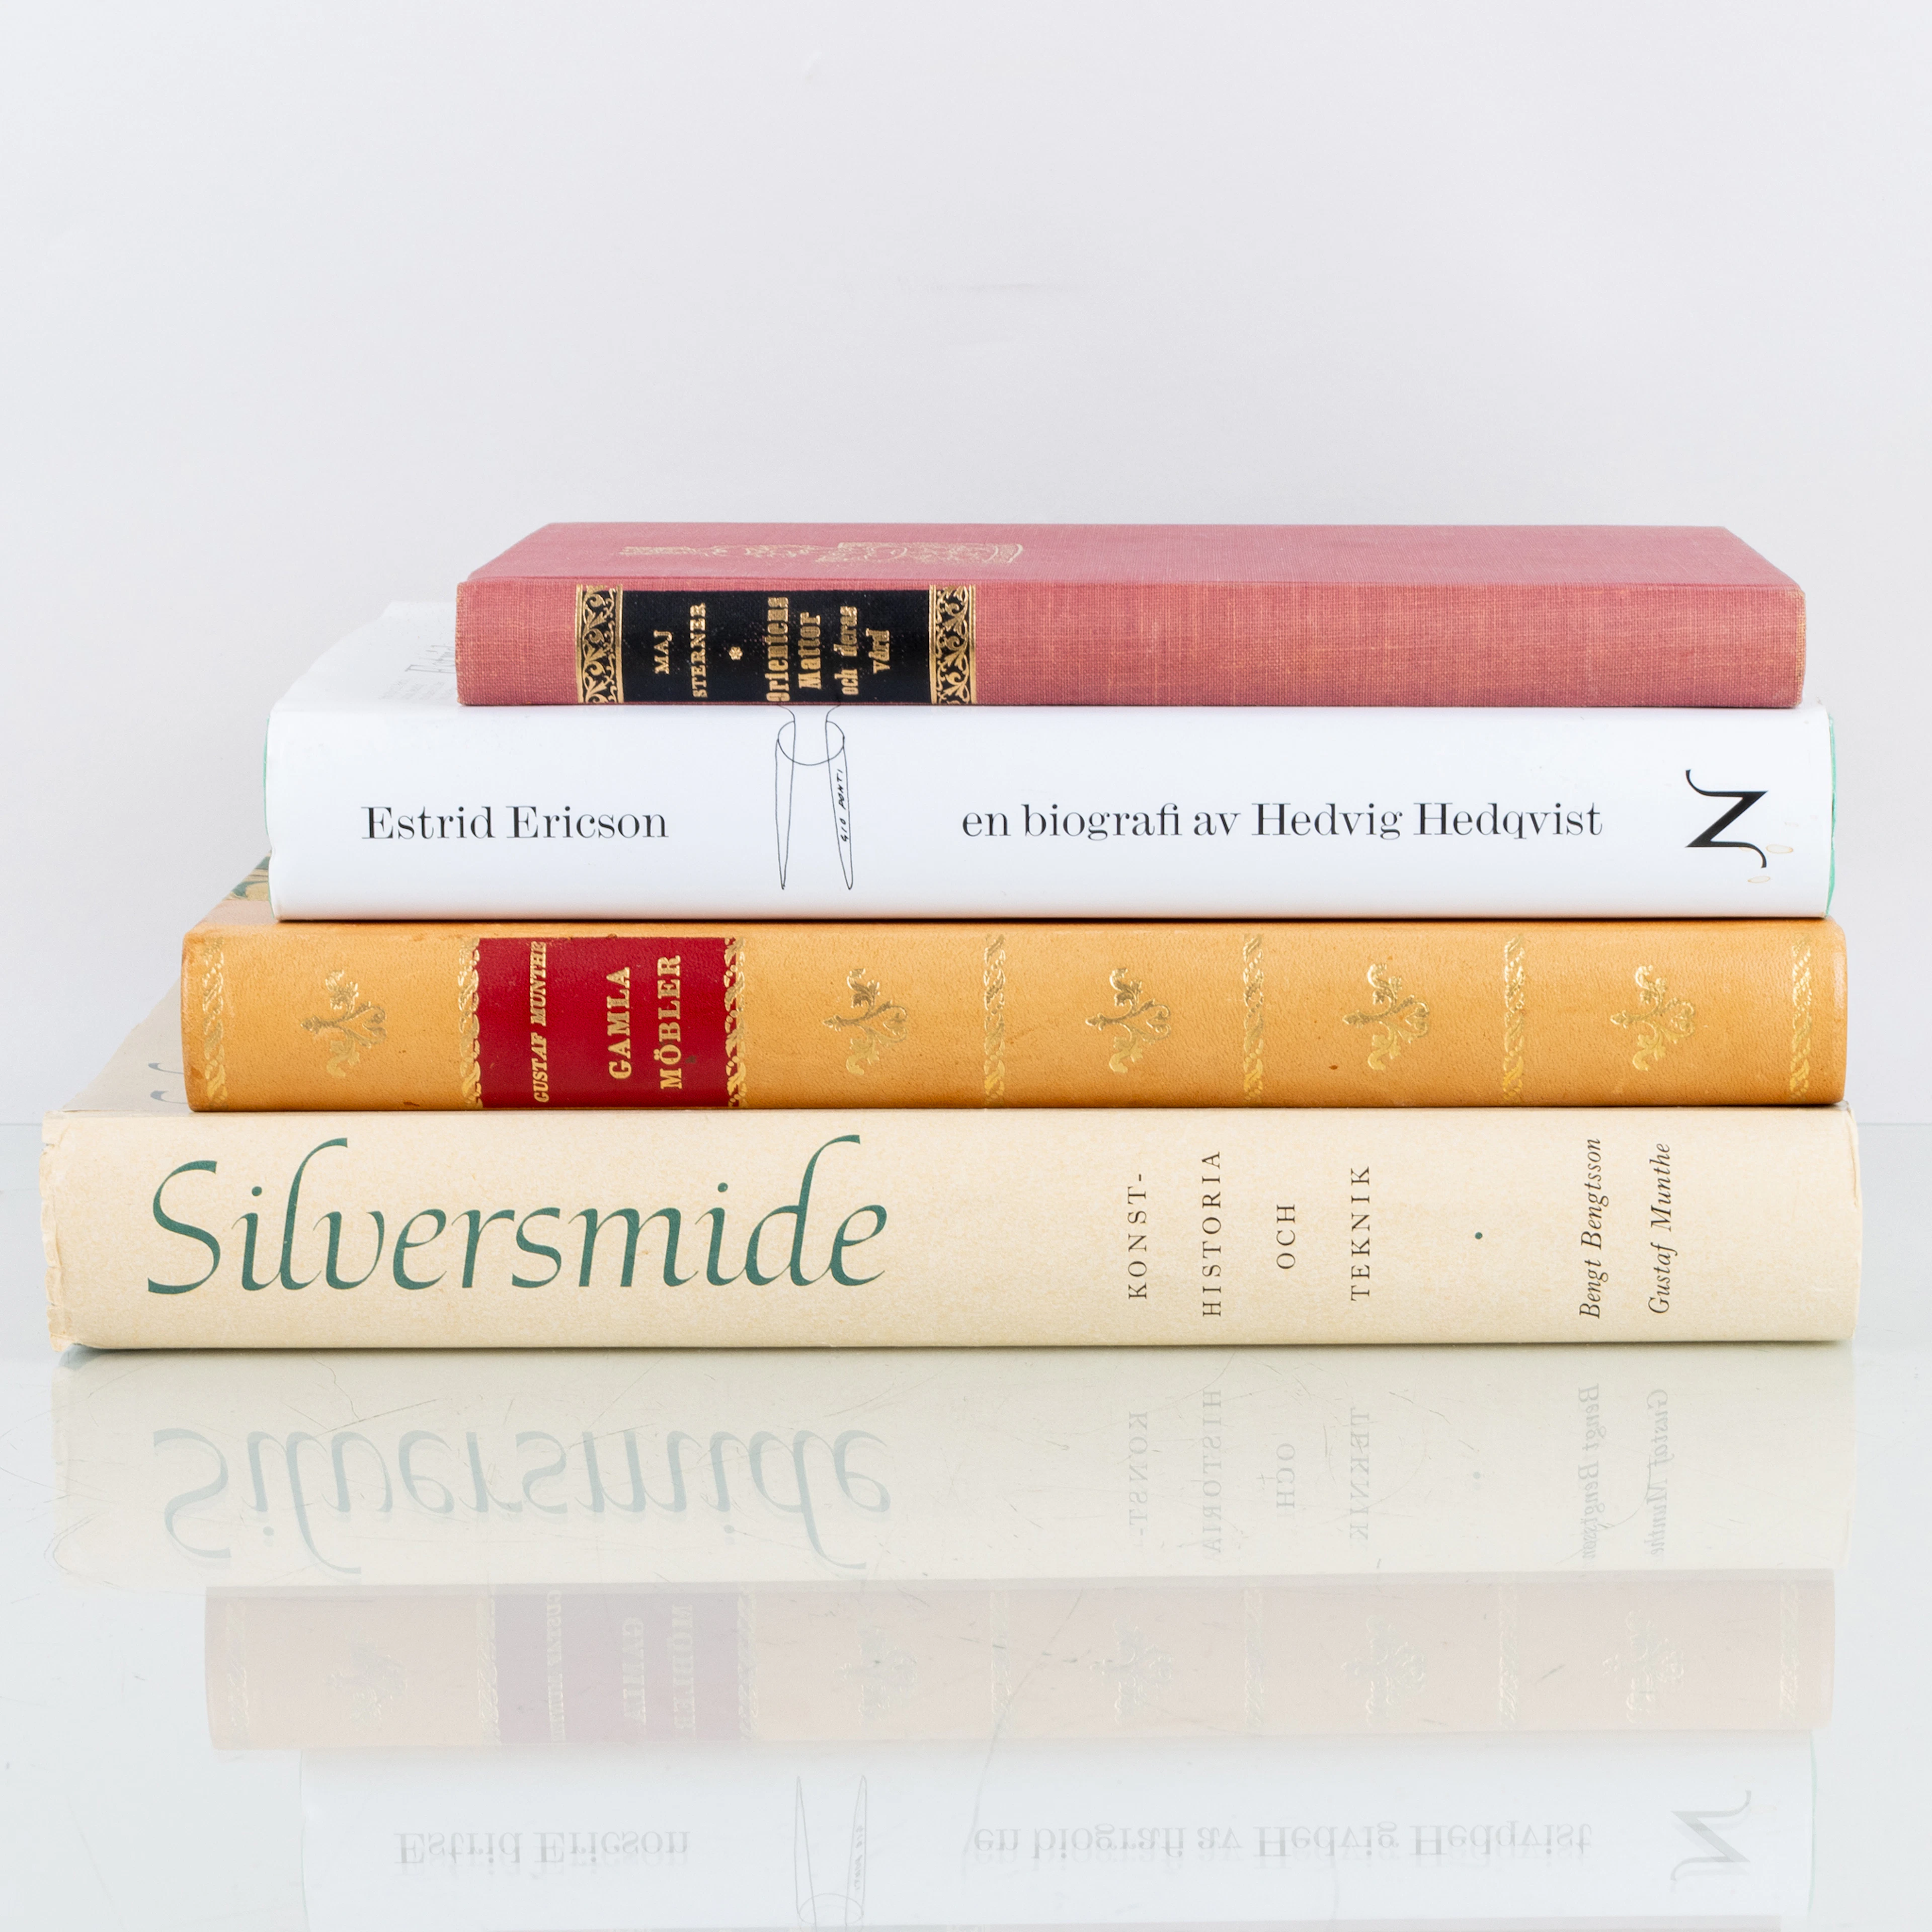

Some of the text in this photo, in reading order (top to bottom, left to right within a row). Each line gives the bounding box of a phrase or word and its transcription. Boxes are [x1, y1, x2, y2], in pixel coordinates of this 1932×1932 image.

[653, 630, 673, 675] MAJ
[689, 603, 707, 698] STERNER
[764, 596, 790, 702] Orientens
[797, 611, 822, 689] Mattor
[833, 606, 859, 695] och deras
[362, 806, 669, 839] Estrid Ericson
[836, 768, 849, 842] GIO PONTI
[962, 801, 1603, 841] en biografi av Hedvig Hedqvist
[529, 941, 550, 1103] GUSTAF MUNTHE
[606, 966, 632, 1080] GAMLA
[653, 954, 683, 1090] MÖBLER
[147, 1134, 888, 1295] Silversmide
[1127, 1172, 1148, 1300] KONST-
[1201, 1151, 1222, 1317] HISTORIA
[1275, 1203, 1296, 1270] OCH
[1350, 1166, 1371, 1302] TEKNIK
[1579, 1139, 1609, 1320] Bengt Bengtsson
[1648, 1143, 1678, 1314] Gustaf Munthe
